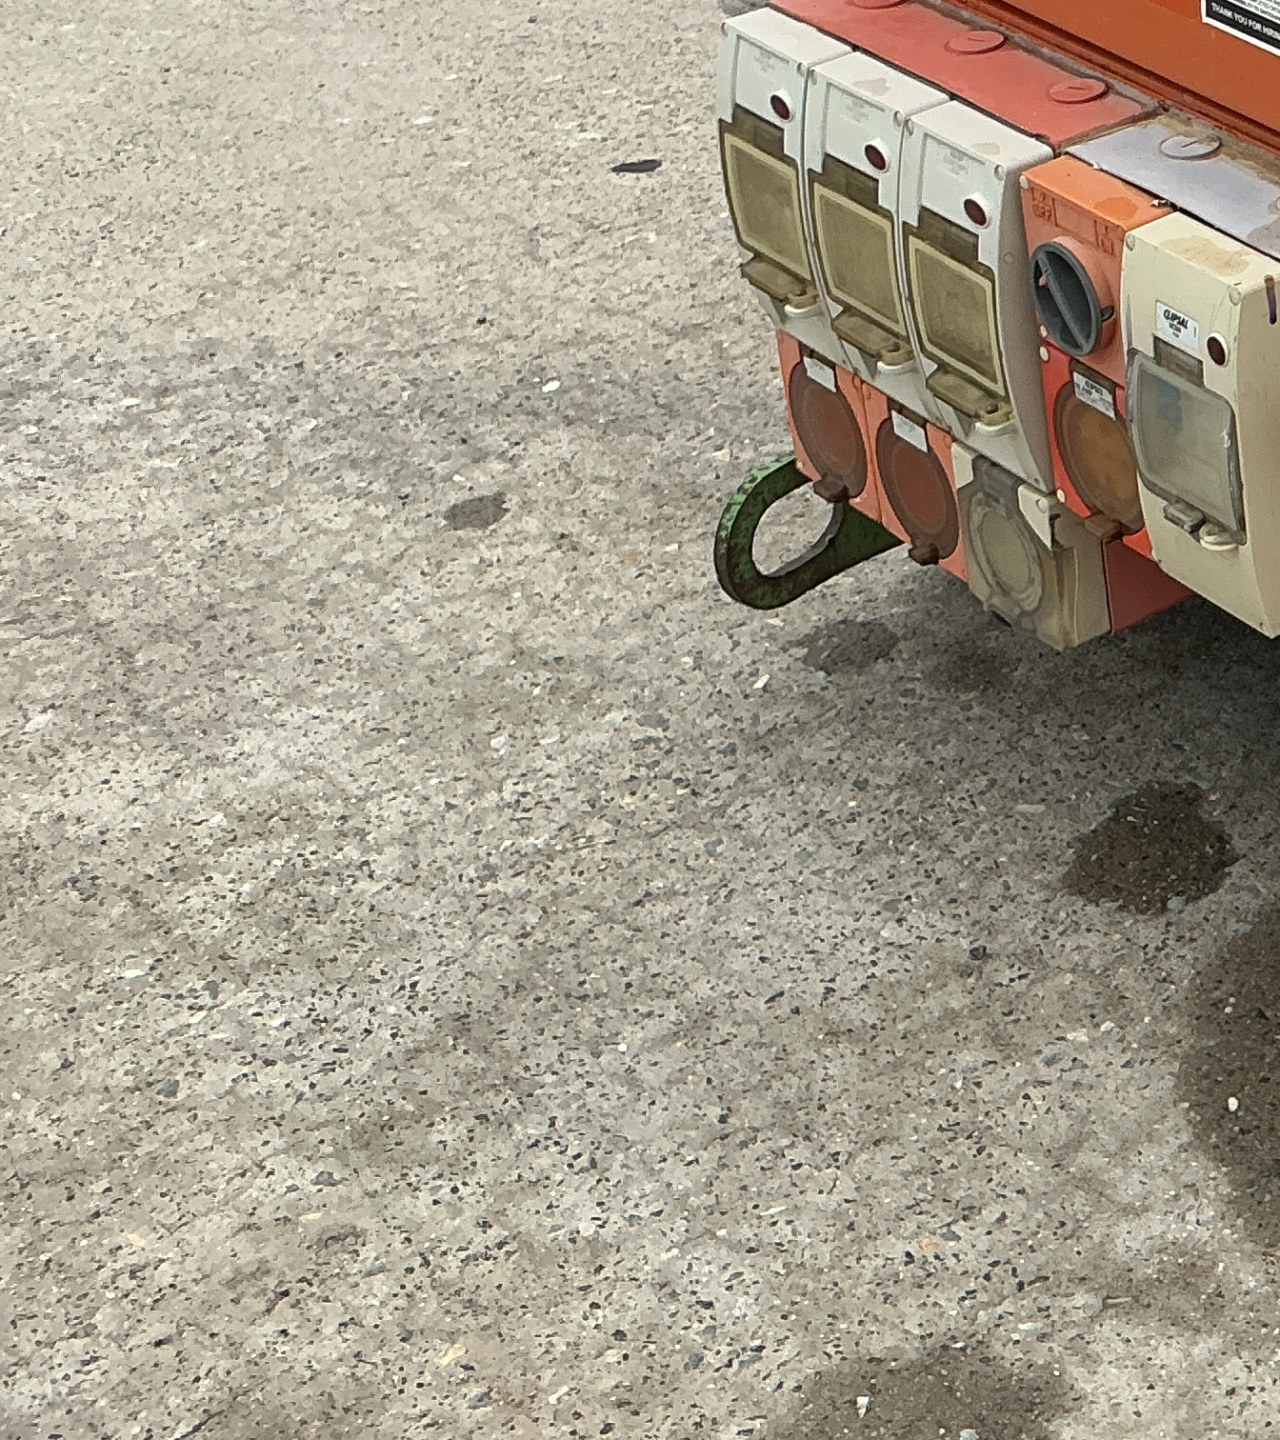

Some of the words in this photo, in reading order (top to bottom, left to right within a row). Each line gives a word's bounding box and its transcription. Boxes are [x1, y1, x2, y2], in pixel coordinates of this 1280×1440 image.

[1210, 1, 1234, 19] THANK
[1233, 13, 1249, 26] YOU
[1249, 19, 1263, 33] FOR
[1163, 308, 1189, 330] CLIPSAL
